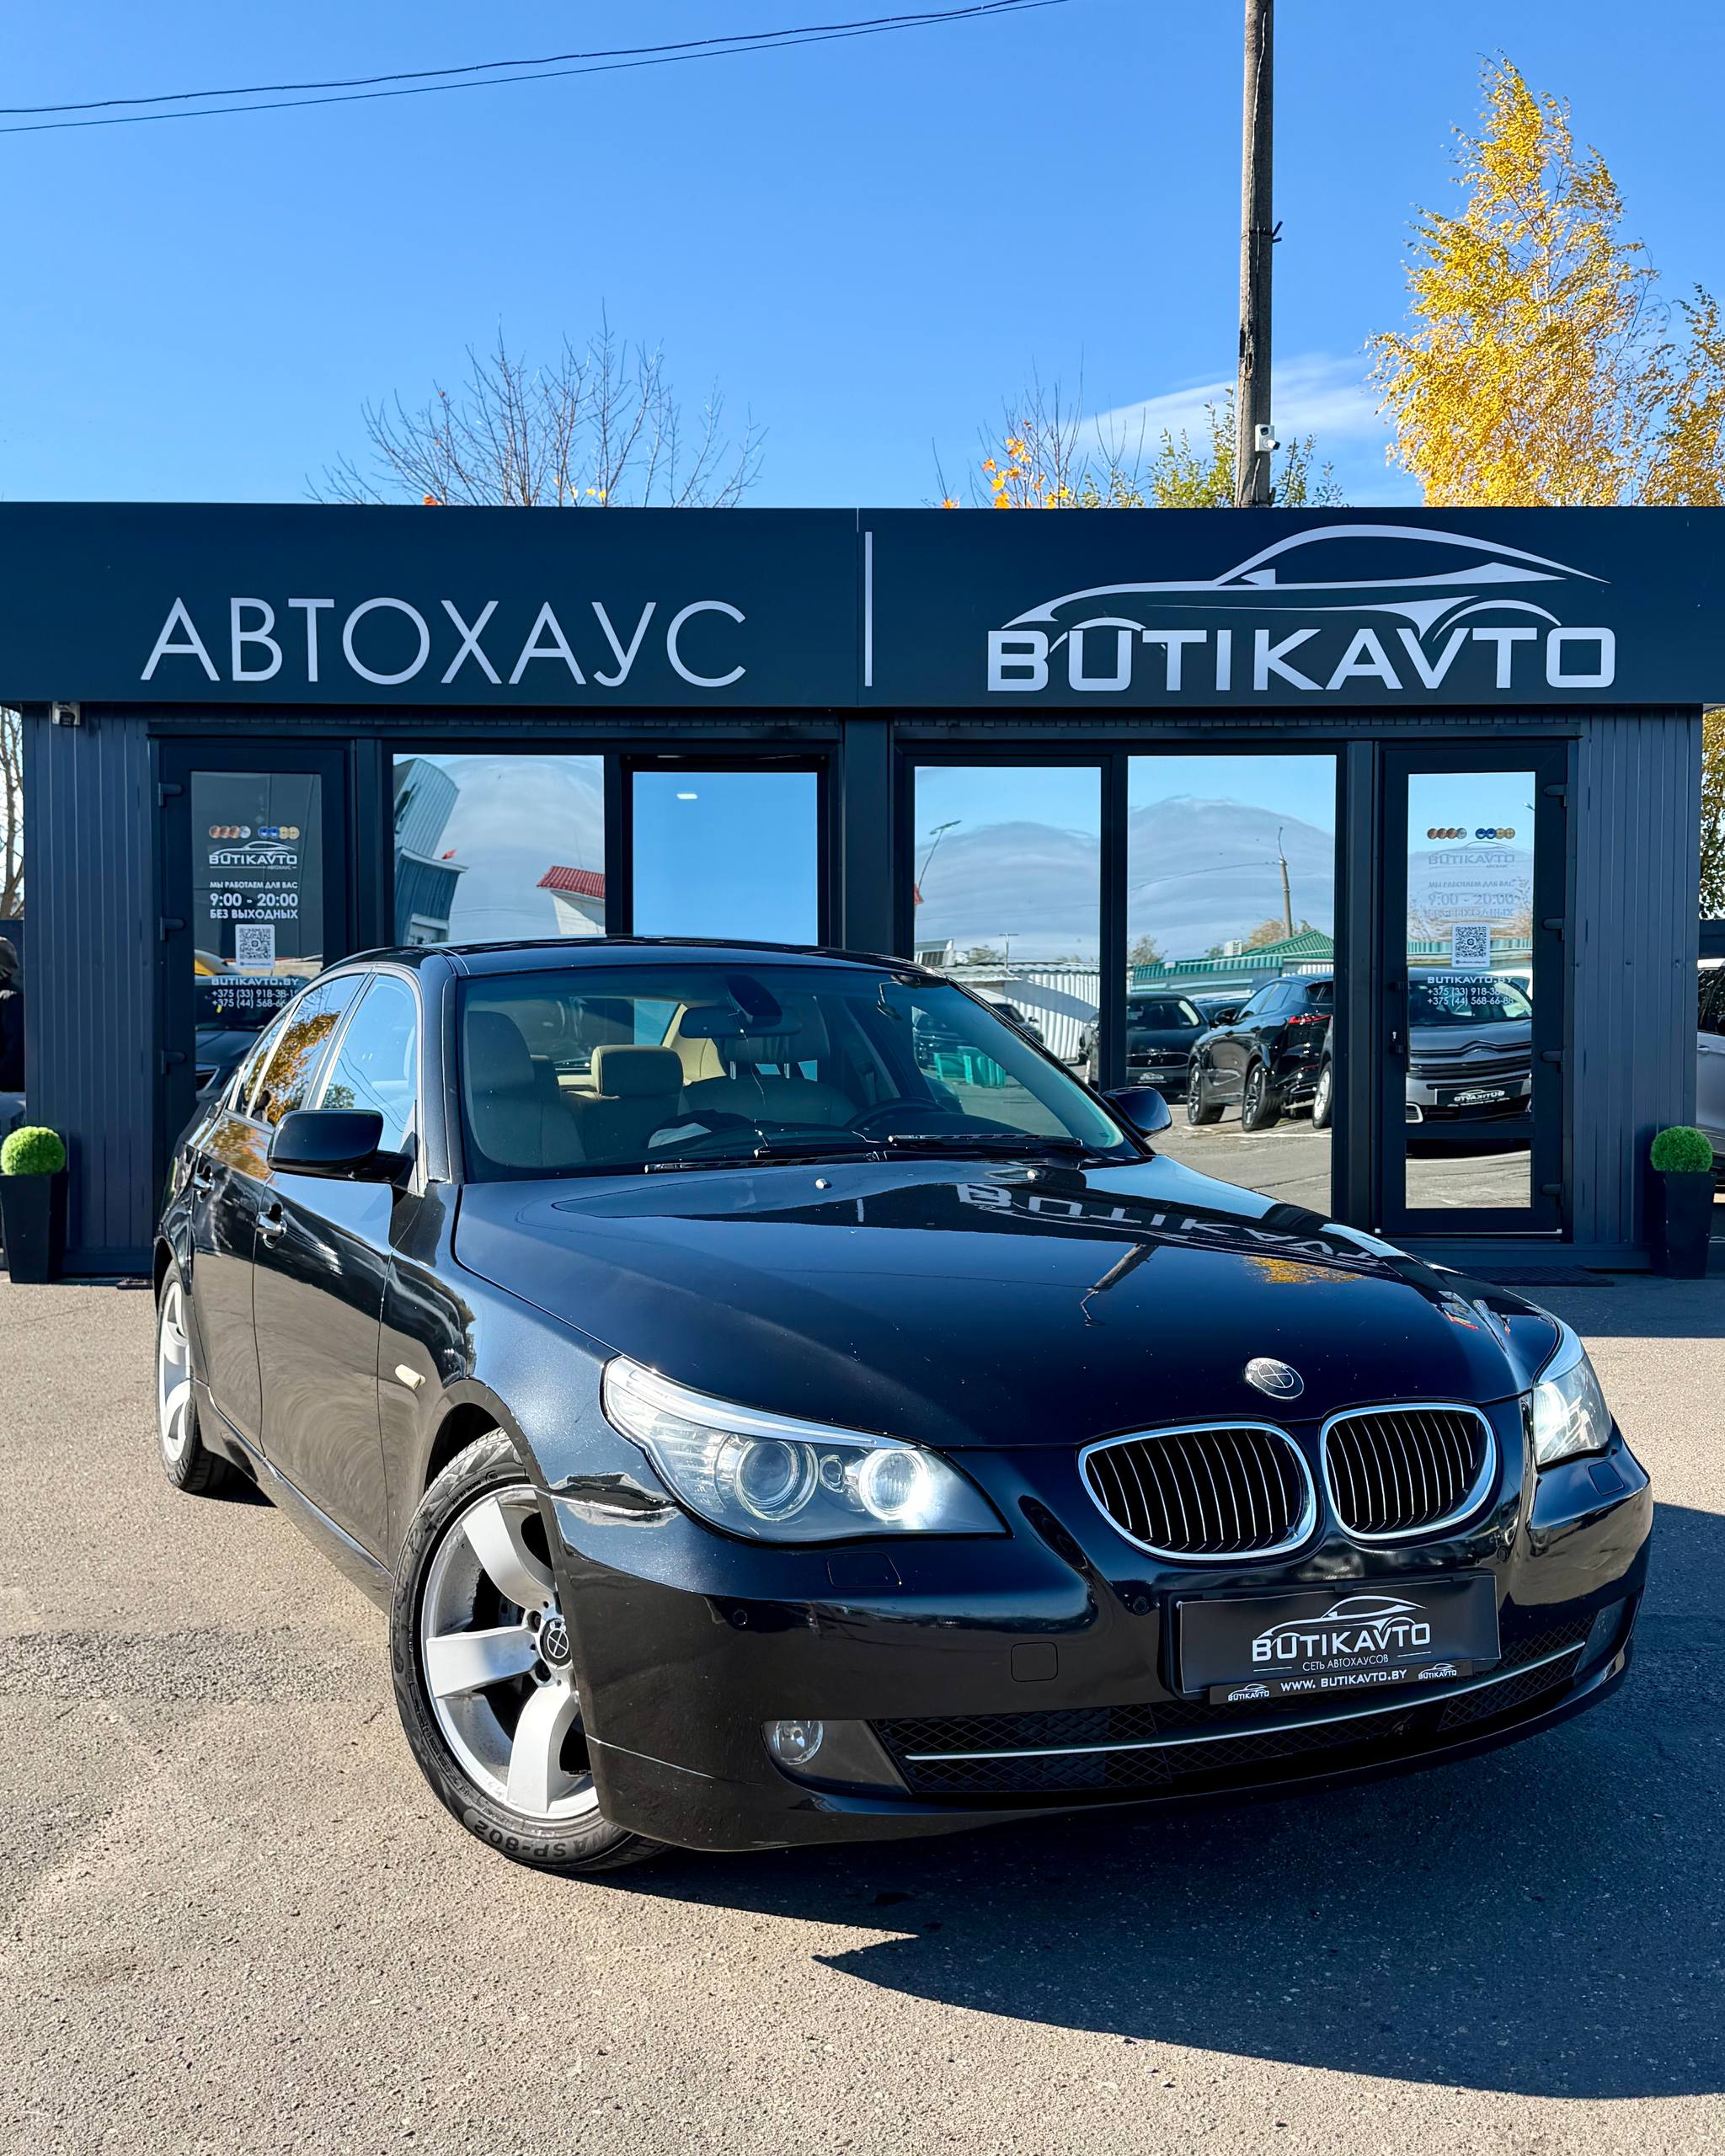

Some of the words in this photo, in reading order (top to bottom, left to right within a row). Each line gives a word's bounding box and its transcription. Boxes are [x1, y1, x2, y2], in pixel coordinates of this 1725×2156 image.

[141, 597, 747, 687] АВТОХАУС
[987, 626, 1617, 691] BUTIKAVTO
[209, 854, 297, 865] BUTIKAVTO
[1429, 854, 1515, 864] BUTIKAVTO
[210, 893, 243, 907] 9:00
[257, 893, 299, 907] 20:00
[1429, 893, 1459, 906] 9:00
[1474, 893, 1514, 905] 20:00
[210, 909, 229, 919] БЕЗ
[231, 909, 299, 921] ВЫХОДНЫХ
[211, 978, 300, 986] BUTIKAVTO.BY
[211, 989, 234, 998] +375
[237, 988, 254, 1000] (33)
[211, 998, 234, 1008] +375
[237, 998, 254, 1009] (44)
[1428, 996, 1450, 1006] +375
[1252, 1622, 1431, 1662] BUTIKAVTO
[1302, 1660, 1326, 1672] СЕТЬ
[1327, 1654, 1389, 1670] АВТОХАУСОВ
[1281, 1679, 1316, 1692] WWW.
[1321, 1669, 1407, 1688] BUTIKAVTO.BY
[1418, 1669, 1457, 1680] BUTIKAVTO
[1227, 1690, 1270, 1702] BUTIKAVTO
[473, 1819, 568, 1858] SP-802
